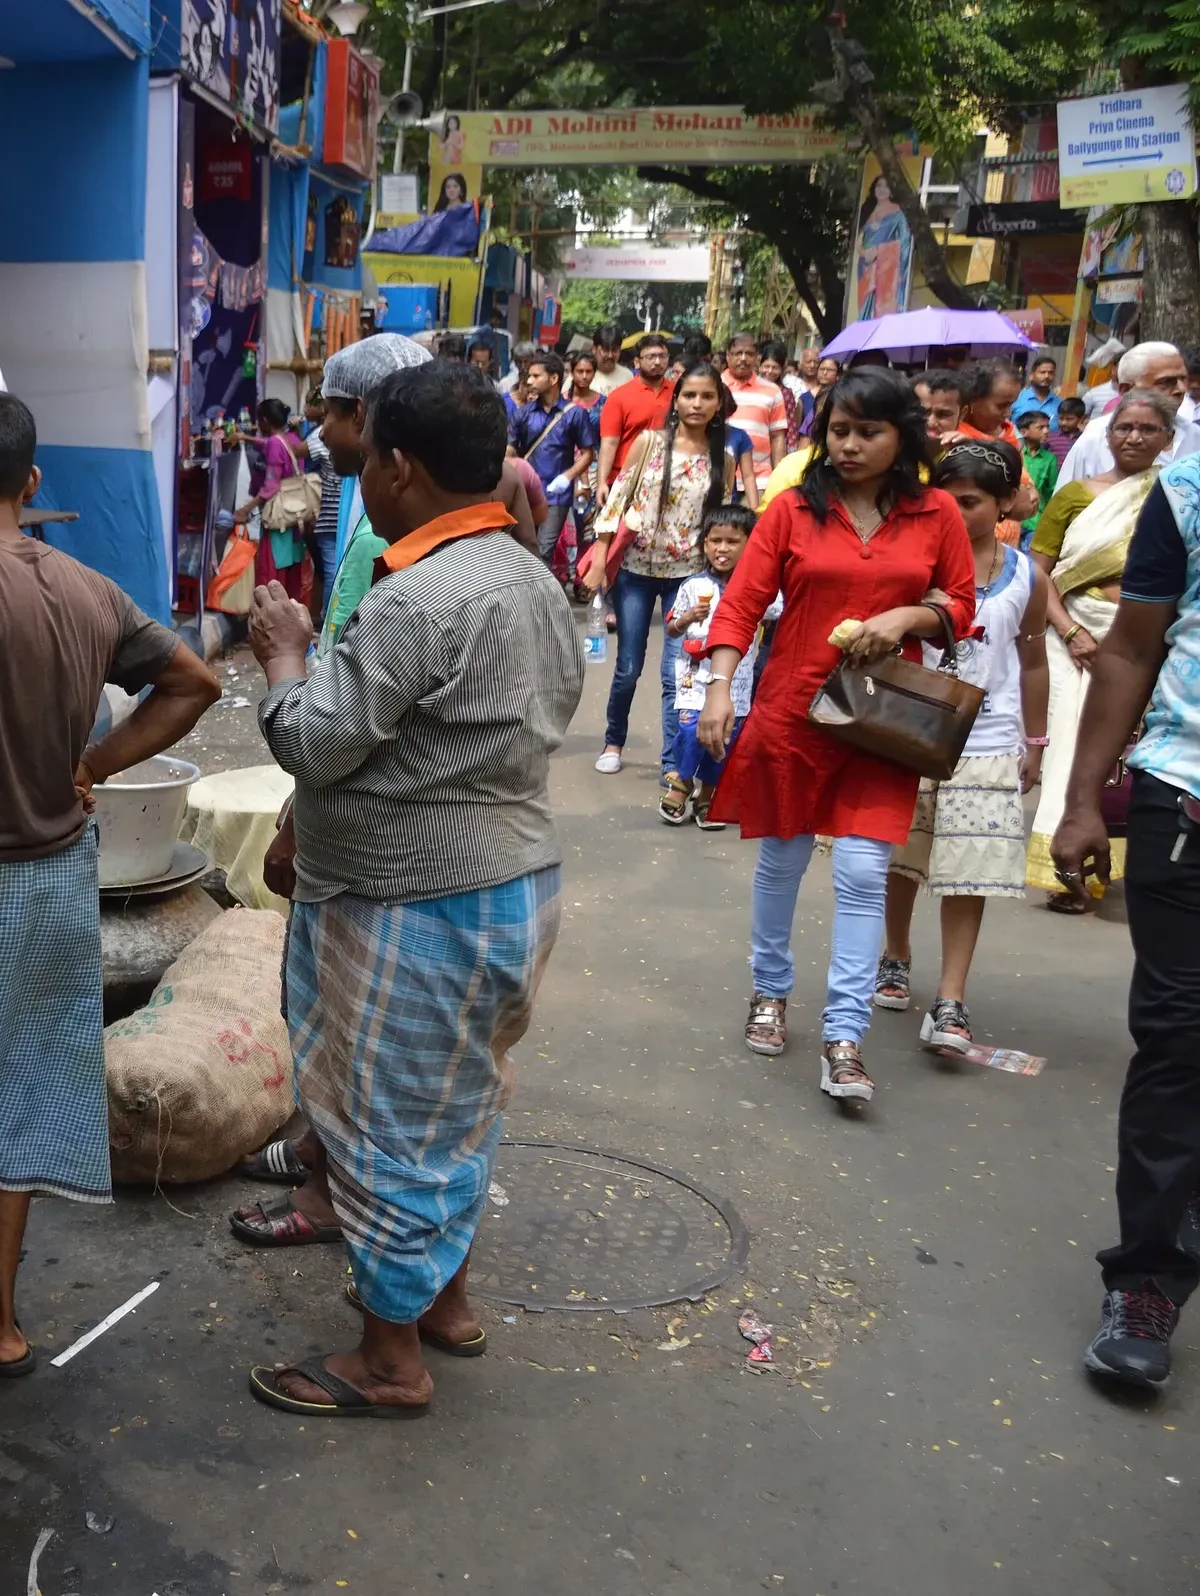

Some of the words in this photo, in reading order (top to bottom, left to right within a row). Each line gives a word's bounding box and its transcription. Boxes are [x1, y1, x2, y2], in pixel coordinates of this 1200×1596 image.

[1099, 98, 1142, 115] Tridhara
[489, 116, 533, 136] ADI
[547, 113, 637, 135] Mohini
[653, 112, 743, 131] Mohan
[1088, 121, 1114, 135] Priya
[1116, 115, 1155, 130] Cinema
[1067, 138, 1123, 156] Ballygunge
[1125, 135, 1140, 149] Rly
[1141, 131, 1180, 148] Station
